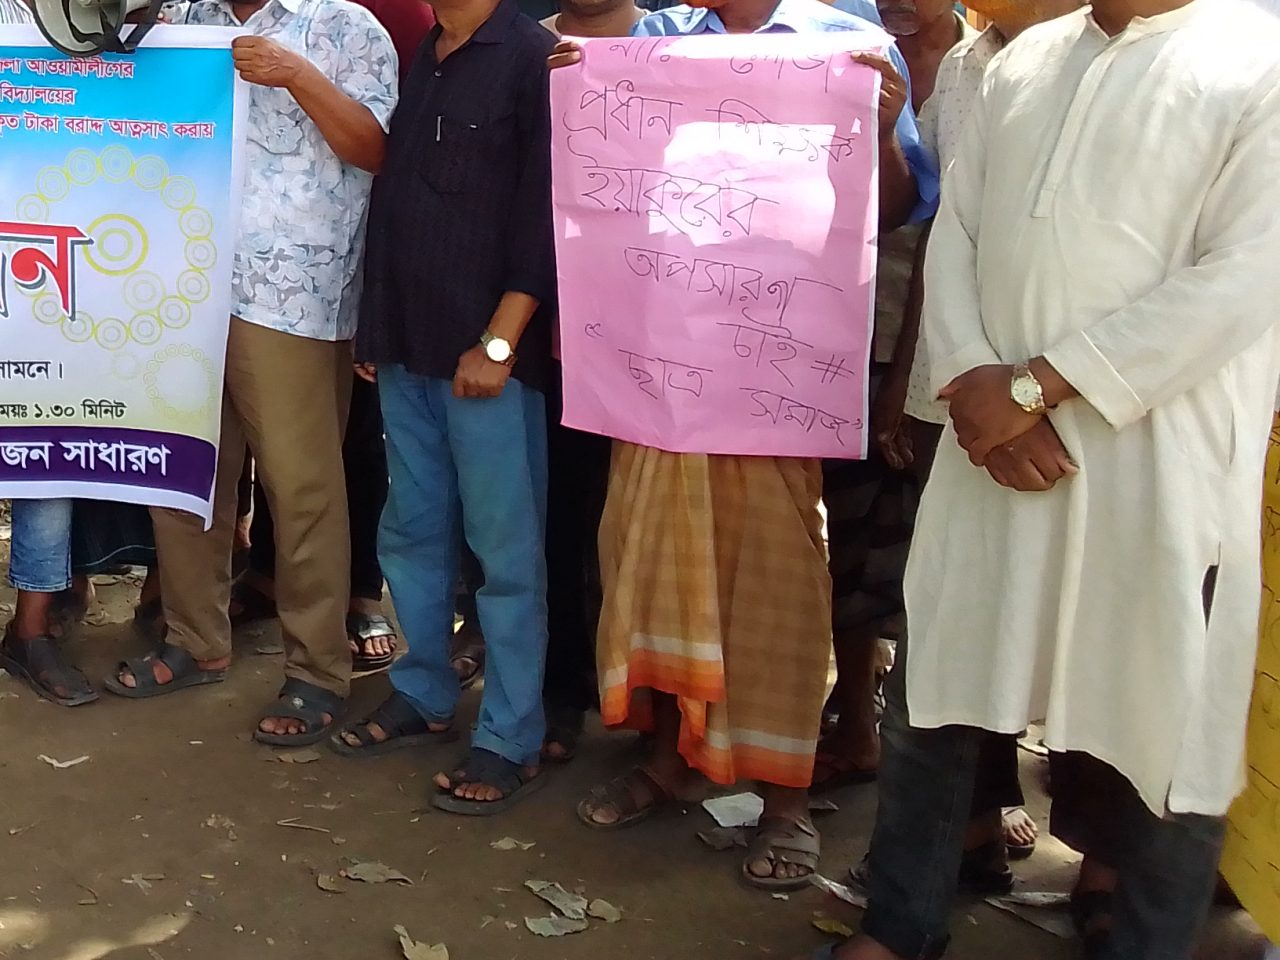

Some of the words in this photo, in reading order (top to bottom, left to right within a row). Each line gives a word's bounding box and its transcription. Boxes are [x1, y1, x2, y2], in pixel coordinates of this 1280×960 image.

[24, 111, 59, 132] টাকা
[172, 123, 215, 139] করায়
[563, 79, 683, 141] প্রধান
[33, 402, 75, 419] ১.৩০
[79, 399, 127, 419] মিনিট
[59, 438, 172, 476] সাধারণ
